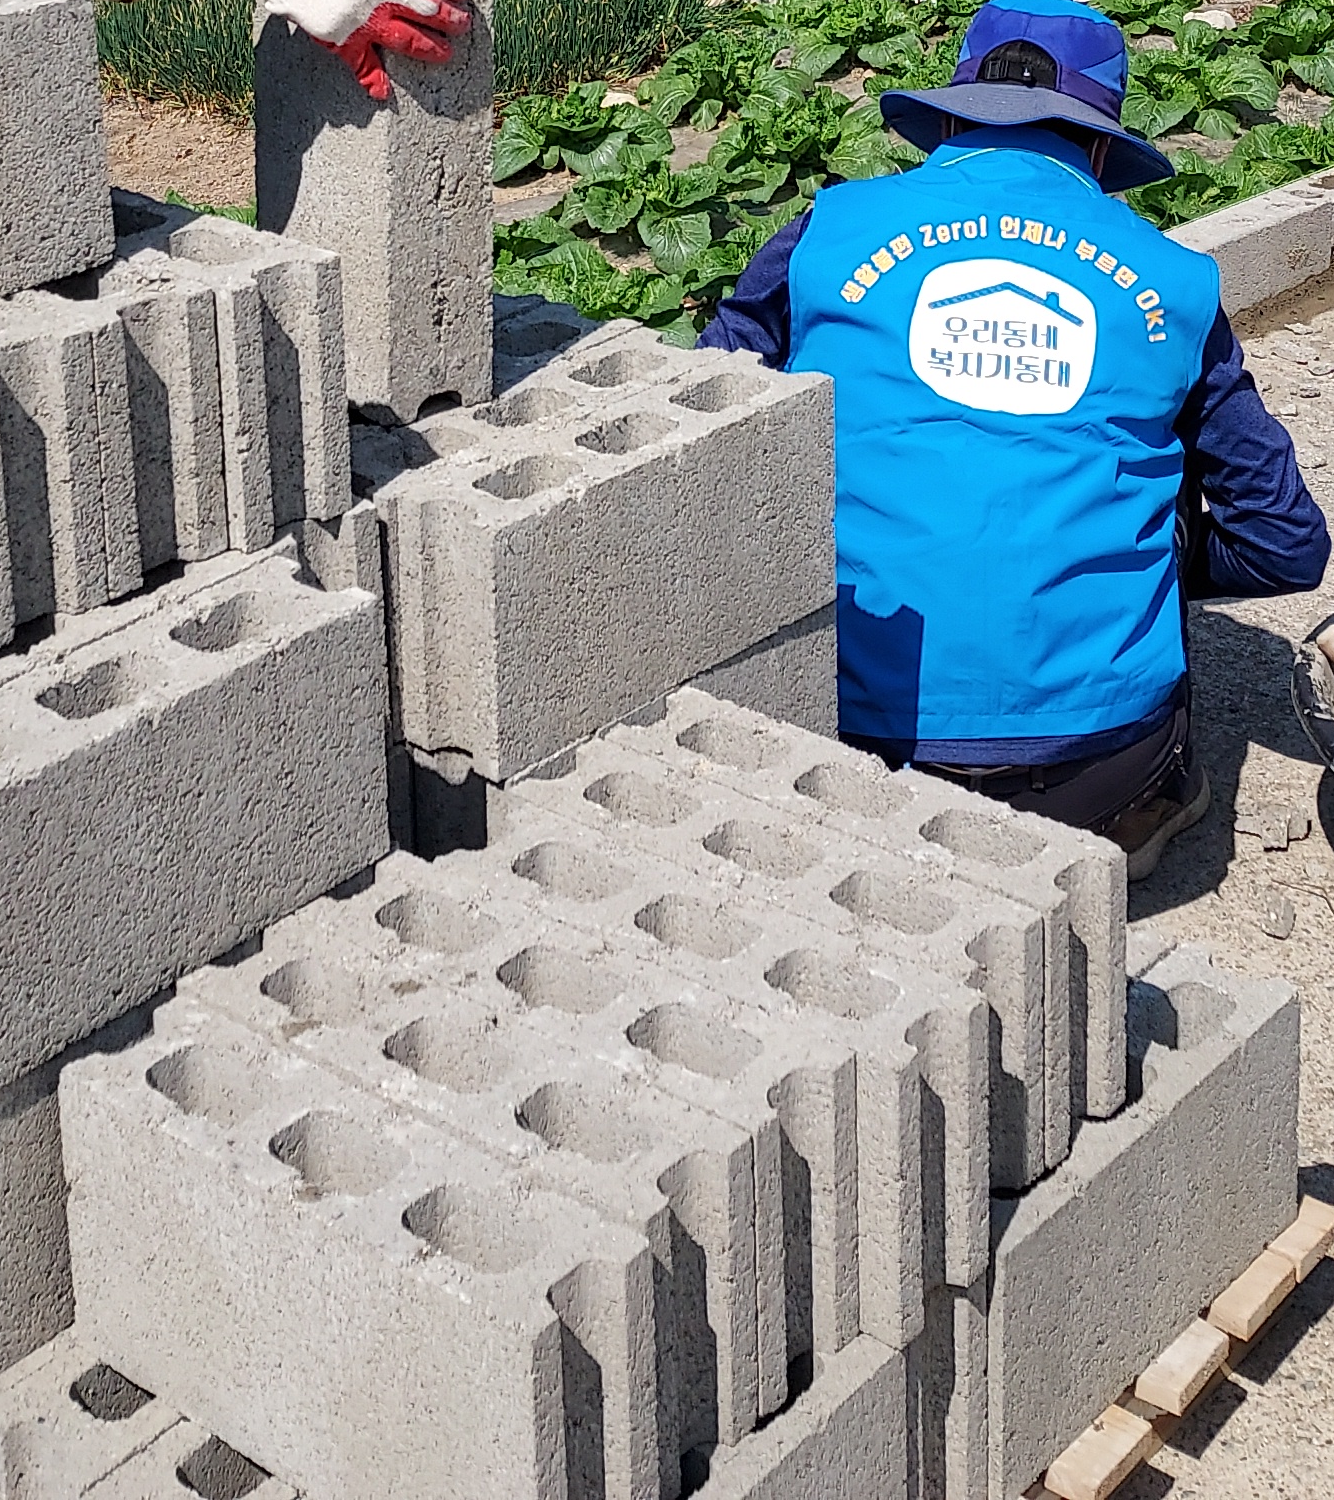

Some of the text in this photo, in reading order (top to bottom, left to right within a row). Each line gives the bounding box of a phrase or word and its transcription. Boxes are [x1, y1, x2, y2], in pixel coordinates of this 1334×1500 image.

[839, 214, 1168, 343] 생활불편 Zero! 언제나 부르면 OK!
[941, 315, 1059, 351] 우리동네
[926, 347, 1072, 389] 복지기동대
